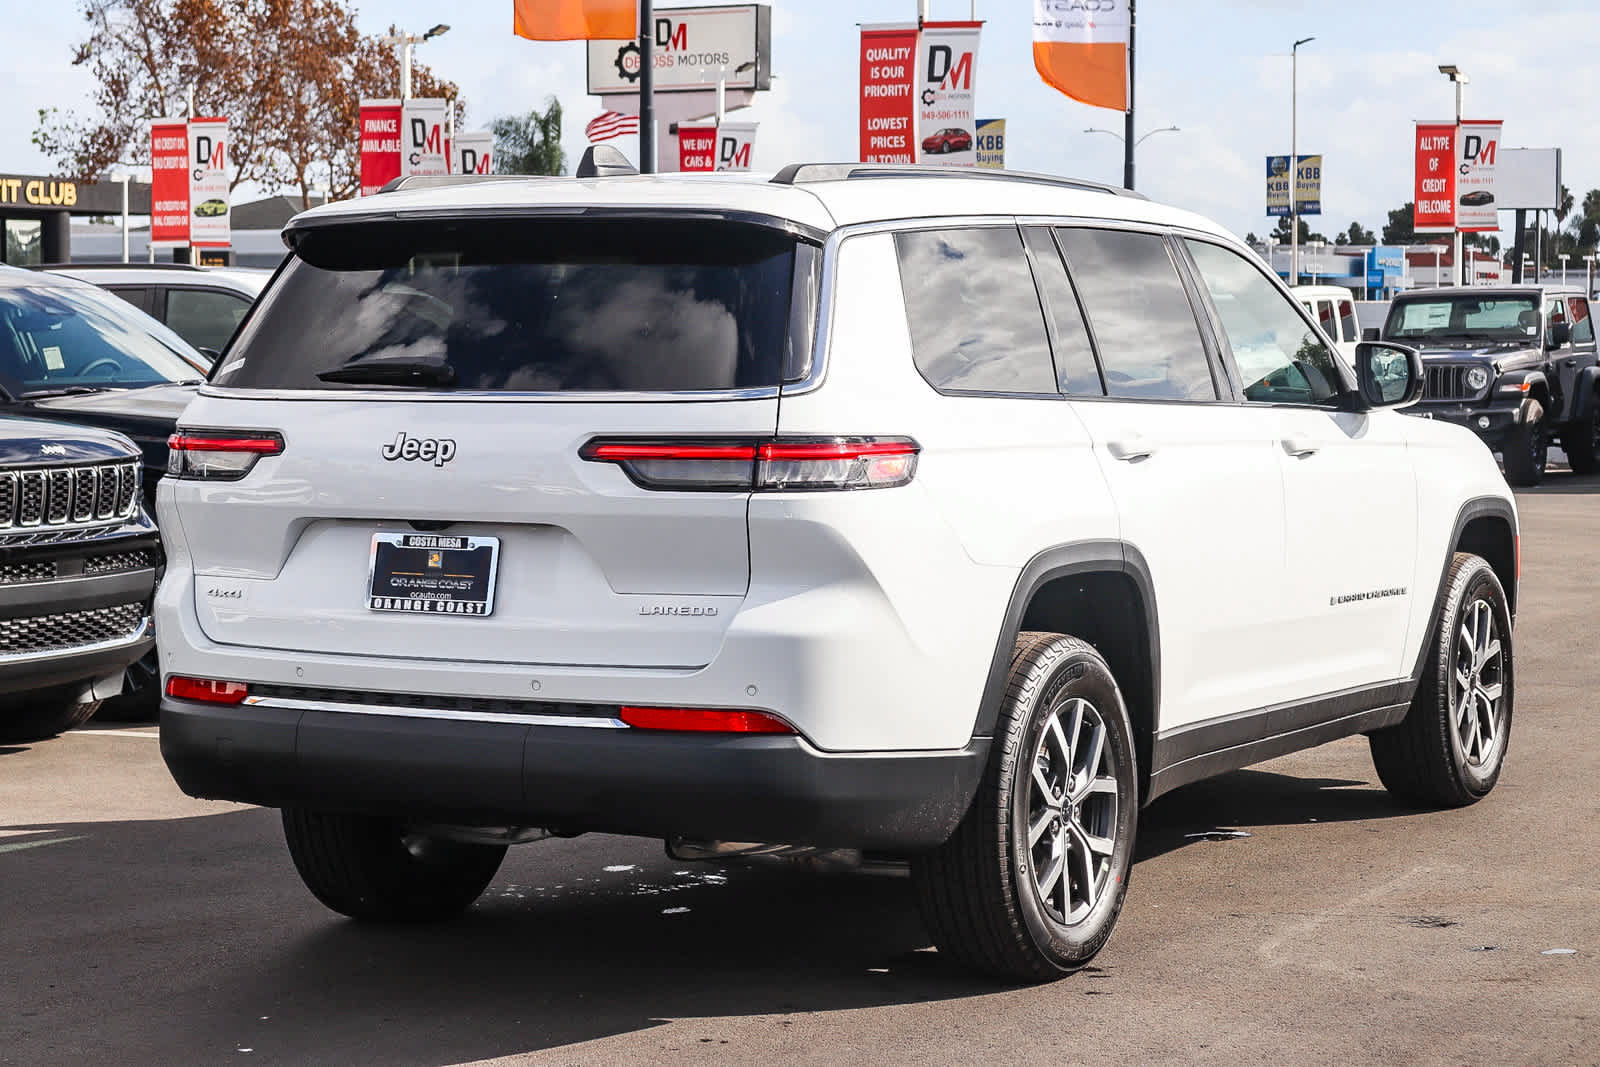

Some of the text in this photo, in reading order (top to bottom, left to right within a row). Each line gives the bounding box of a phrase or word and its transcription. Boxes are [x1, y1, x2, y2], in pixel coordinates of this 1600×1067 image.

[678, 53, 729, 66] MOTORS
[866, 47, 911, 61] QUALITY
[871, 66, 904, 78] IS OUR
[928, 45, 973, 90] DM
[864, 84, 911, 97] PRIORITY
[365, 119, 397, 132] FINANCE
[867, 117, 908, 130] LOWEST
[411, 118, 441, 154] DM
[871, 136, 905, 148] PRICES
[361, 139, 401, 152] AVAILABLE
[682, 138, 713, 150] WE BUY
[976, 135, 1004, 151] KBB
[1420, 136, 1450, 150] ALL TYPE
[197, 136, 224, 170] DM
[720, 137, 751, 167] DM
[1464, 135, 1497, 165] DM
[684, 155, 713, 167] CARS &
[879, 154, 911, 163] TOWN
[976, 152, 1004, 164] Buying
[1429, 159, 1440, 172] OF
[1297, 167, 1320, 180] KBB
[1422, 179, 1446, 192] CREDIT
[25, 180, 77, 206] CLUB
[1418, 200, 1451, 214] WELCOME
[382, 432, 456, 467] Jeep
[409, 537, 462, 549] COSTA MESA
[390, 577, 474, 590] ORANGE COAST
[409, 592, 452, 600] ocauto.com
[374, 598, 484, 614] ORANGE COAST
[639, 605, 719, 617] LAREDO
